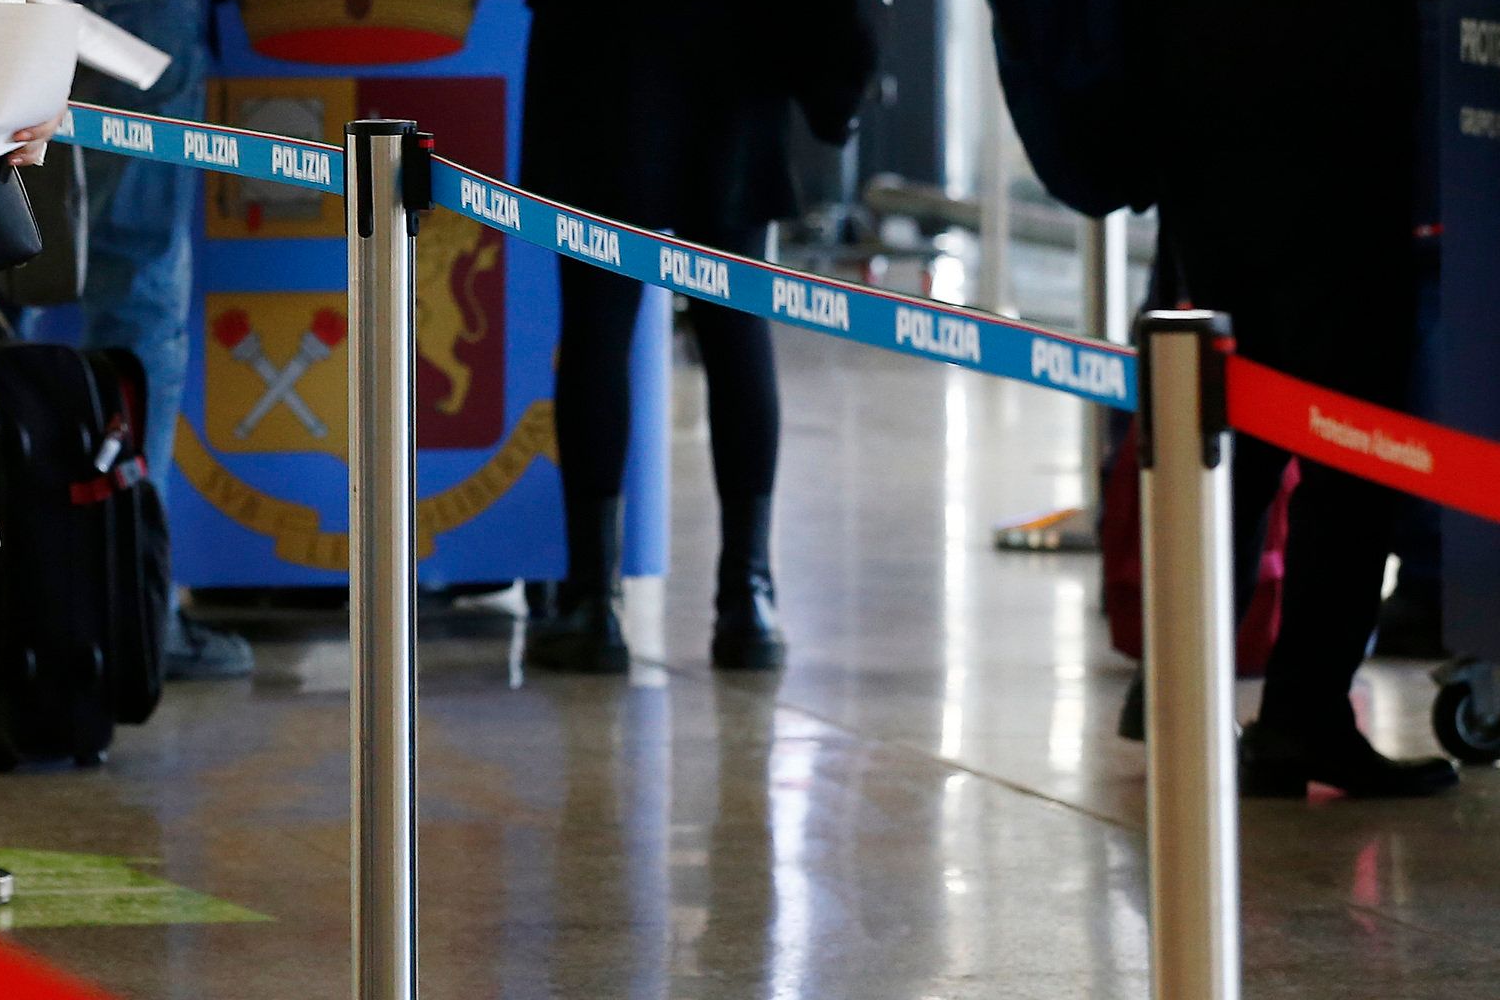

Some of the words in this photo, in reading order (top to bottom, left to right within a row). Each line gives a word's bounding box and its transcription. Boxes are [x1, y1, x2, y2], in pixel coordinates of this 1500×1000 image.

[102, 116, 154, 153] POLIZIA
[184, 130, 239, 168] POLIZIA
[272, 144, 331, 185] POLIZIA
[460, 177, 521, 231] POLIZIA
[556, 213, 620, 267] POLIZIA
[659, 247, 730, 299] POLIZIA
[772, 276, 850, 332] POLIZIA
[895, 306, 981, 363] POLIZIA
[1031, 338, 1126, 399] POLIZIA
